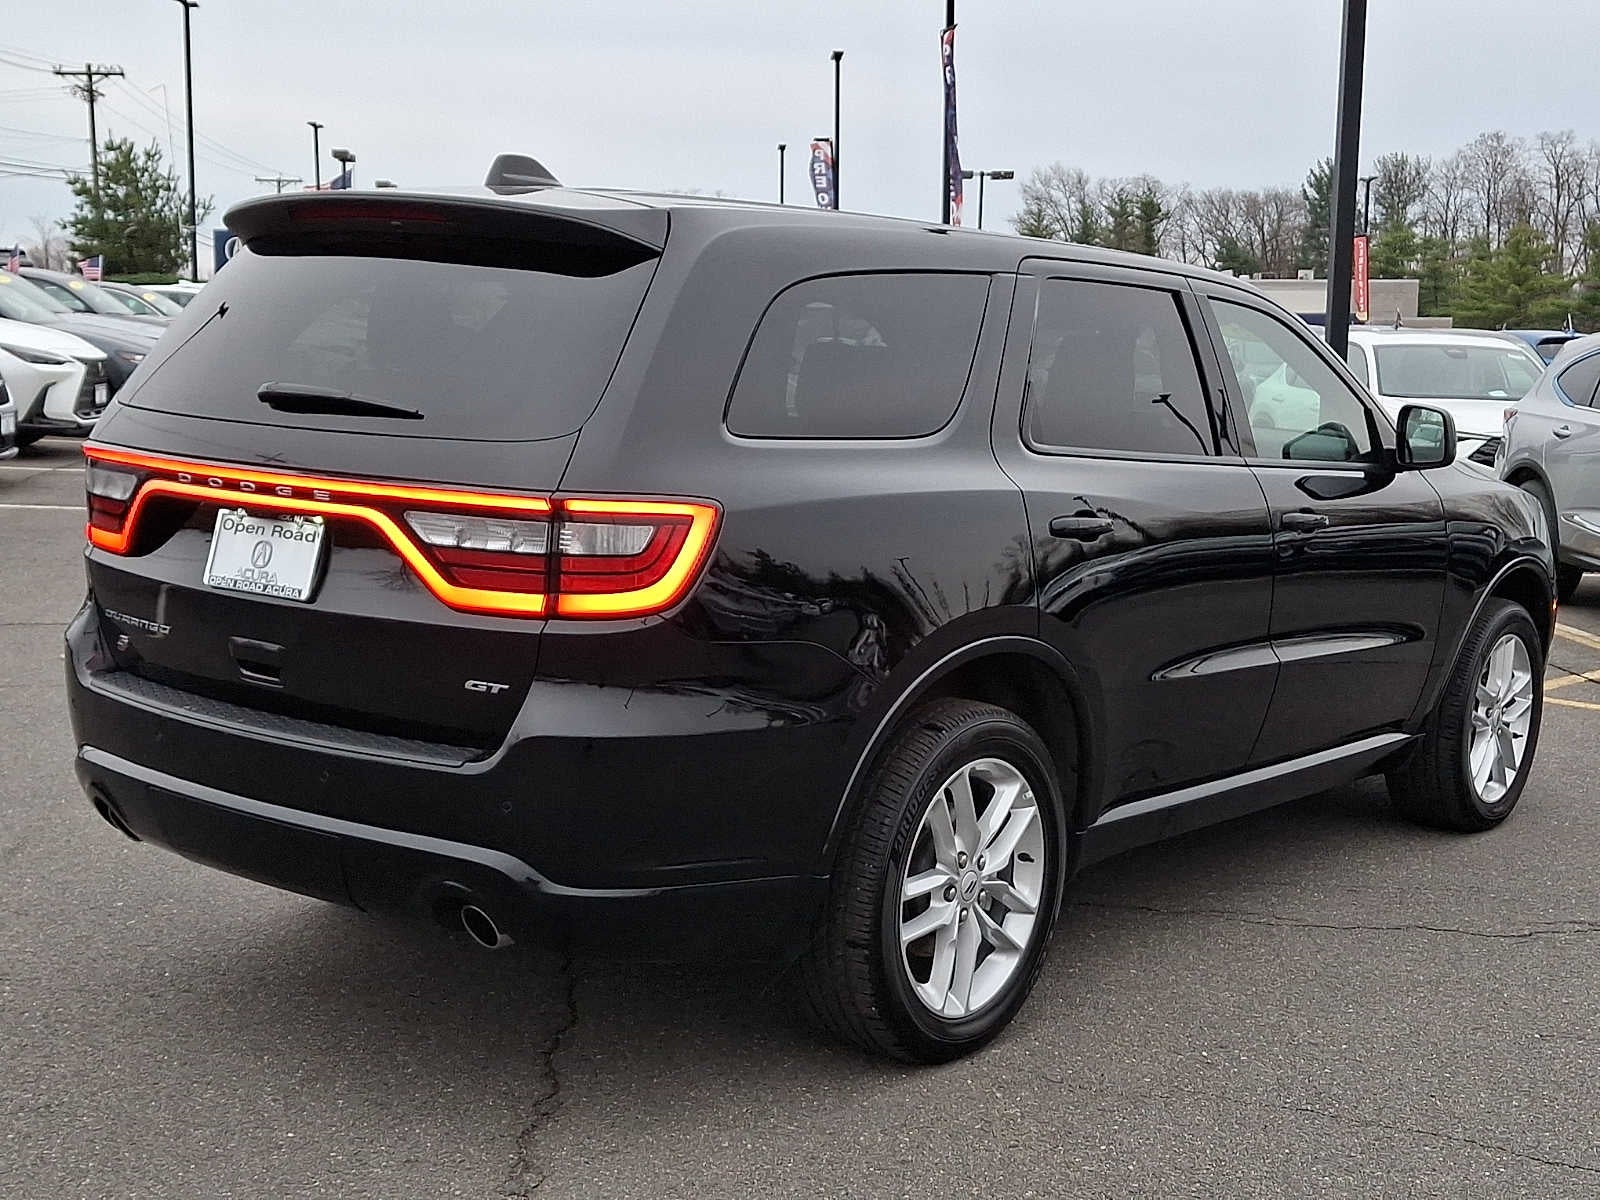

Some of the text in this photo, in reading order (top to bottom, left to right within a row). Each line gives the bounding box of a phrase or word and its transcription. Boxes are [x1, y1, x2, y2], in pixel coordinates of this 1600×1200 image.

[177, 472, 331, 501] DODGE
[223, 518, 265, 535] Open
[271, 525, 317, 543] Road
[210, 576, 300, 598] OPEN ROAD ACURA
[235, 567, 278, 585] ACURA
[104, 608, 172, 635] DURANGO
[464, 679, 511, 694] GT
